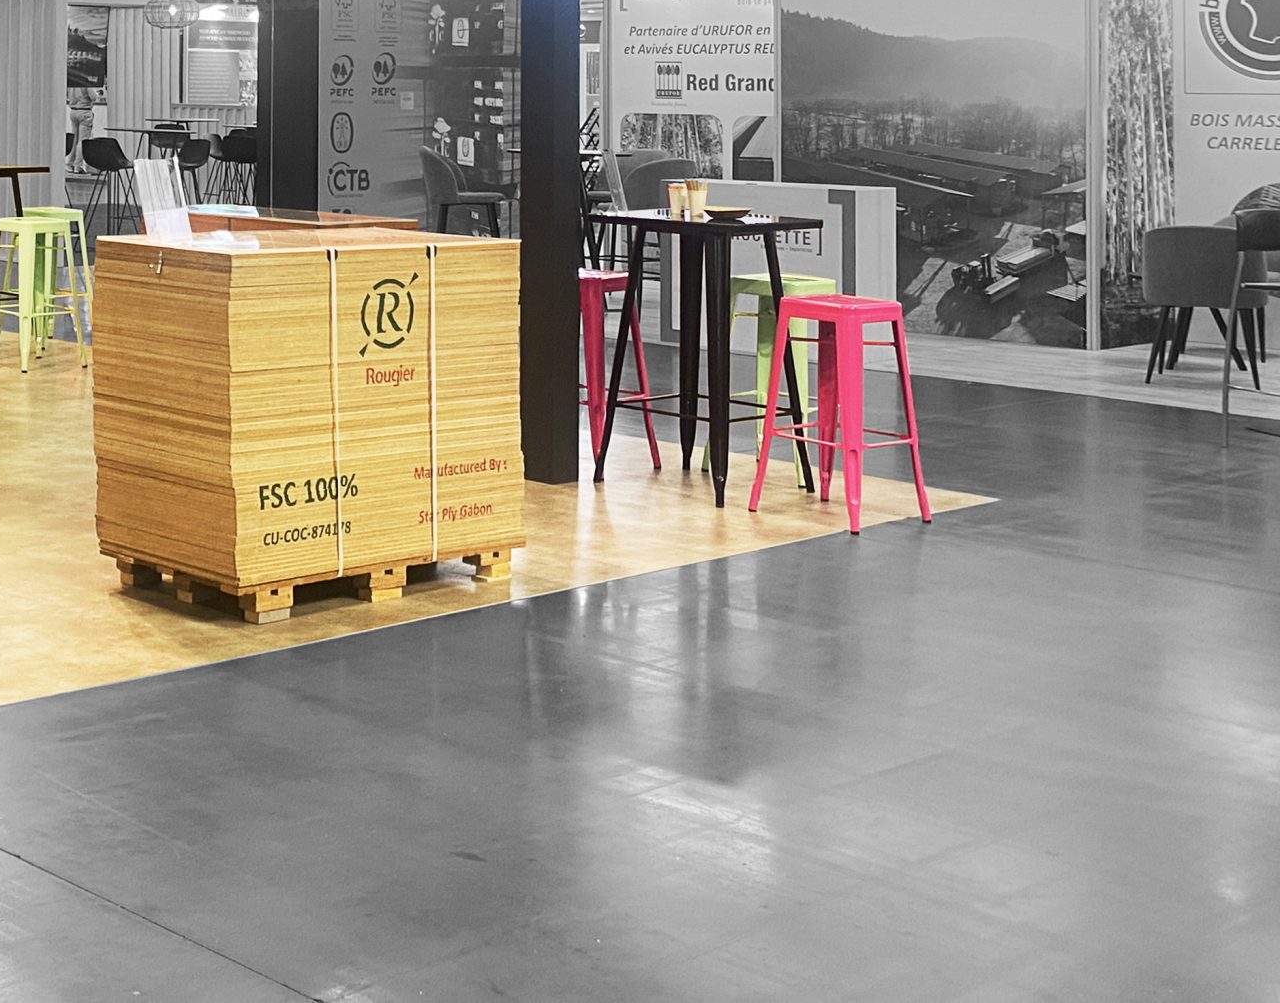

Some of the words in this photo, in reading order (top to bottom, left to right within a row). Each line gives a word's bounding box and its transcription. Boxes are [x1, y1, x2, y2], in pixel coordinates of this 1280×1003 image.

[629, 25, 688, 37] Partenaire
[756, 26, 771, 36] en
[624, 44, 635, 55] et
[638, 43, 673, 55] Avivés
[676, 43, 751, 55] EUCALYPTUS
[687, 74, 718, 91] Red
[330, 88, 354, 97] PEFC
[371, 87, 397, 96] PEFC
[1190, 114, 1230, 127] BOIS
[366, 366, 415, 386] Rougier
[414, 460, 486, 480] Maufactured
[259, 482, 297, 510] FSC
[304, 474, 358, 504] 100%
[442, 507, 457, 522] Ply
[460, 504, 492, 518] Gabon
